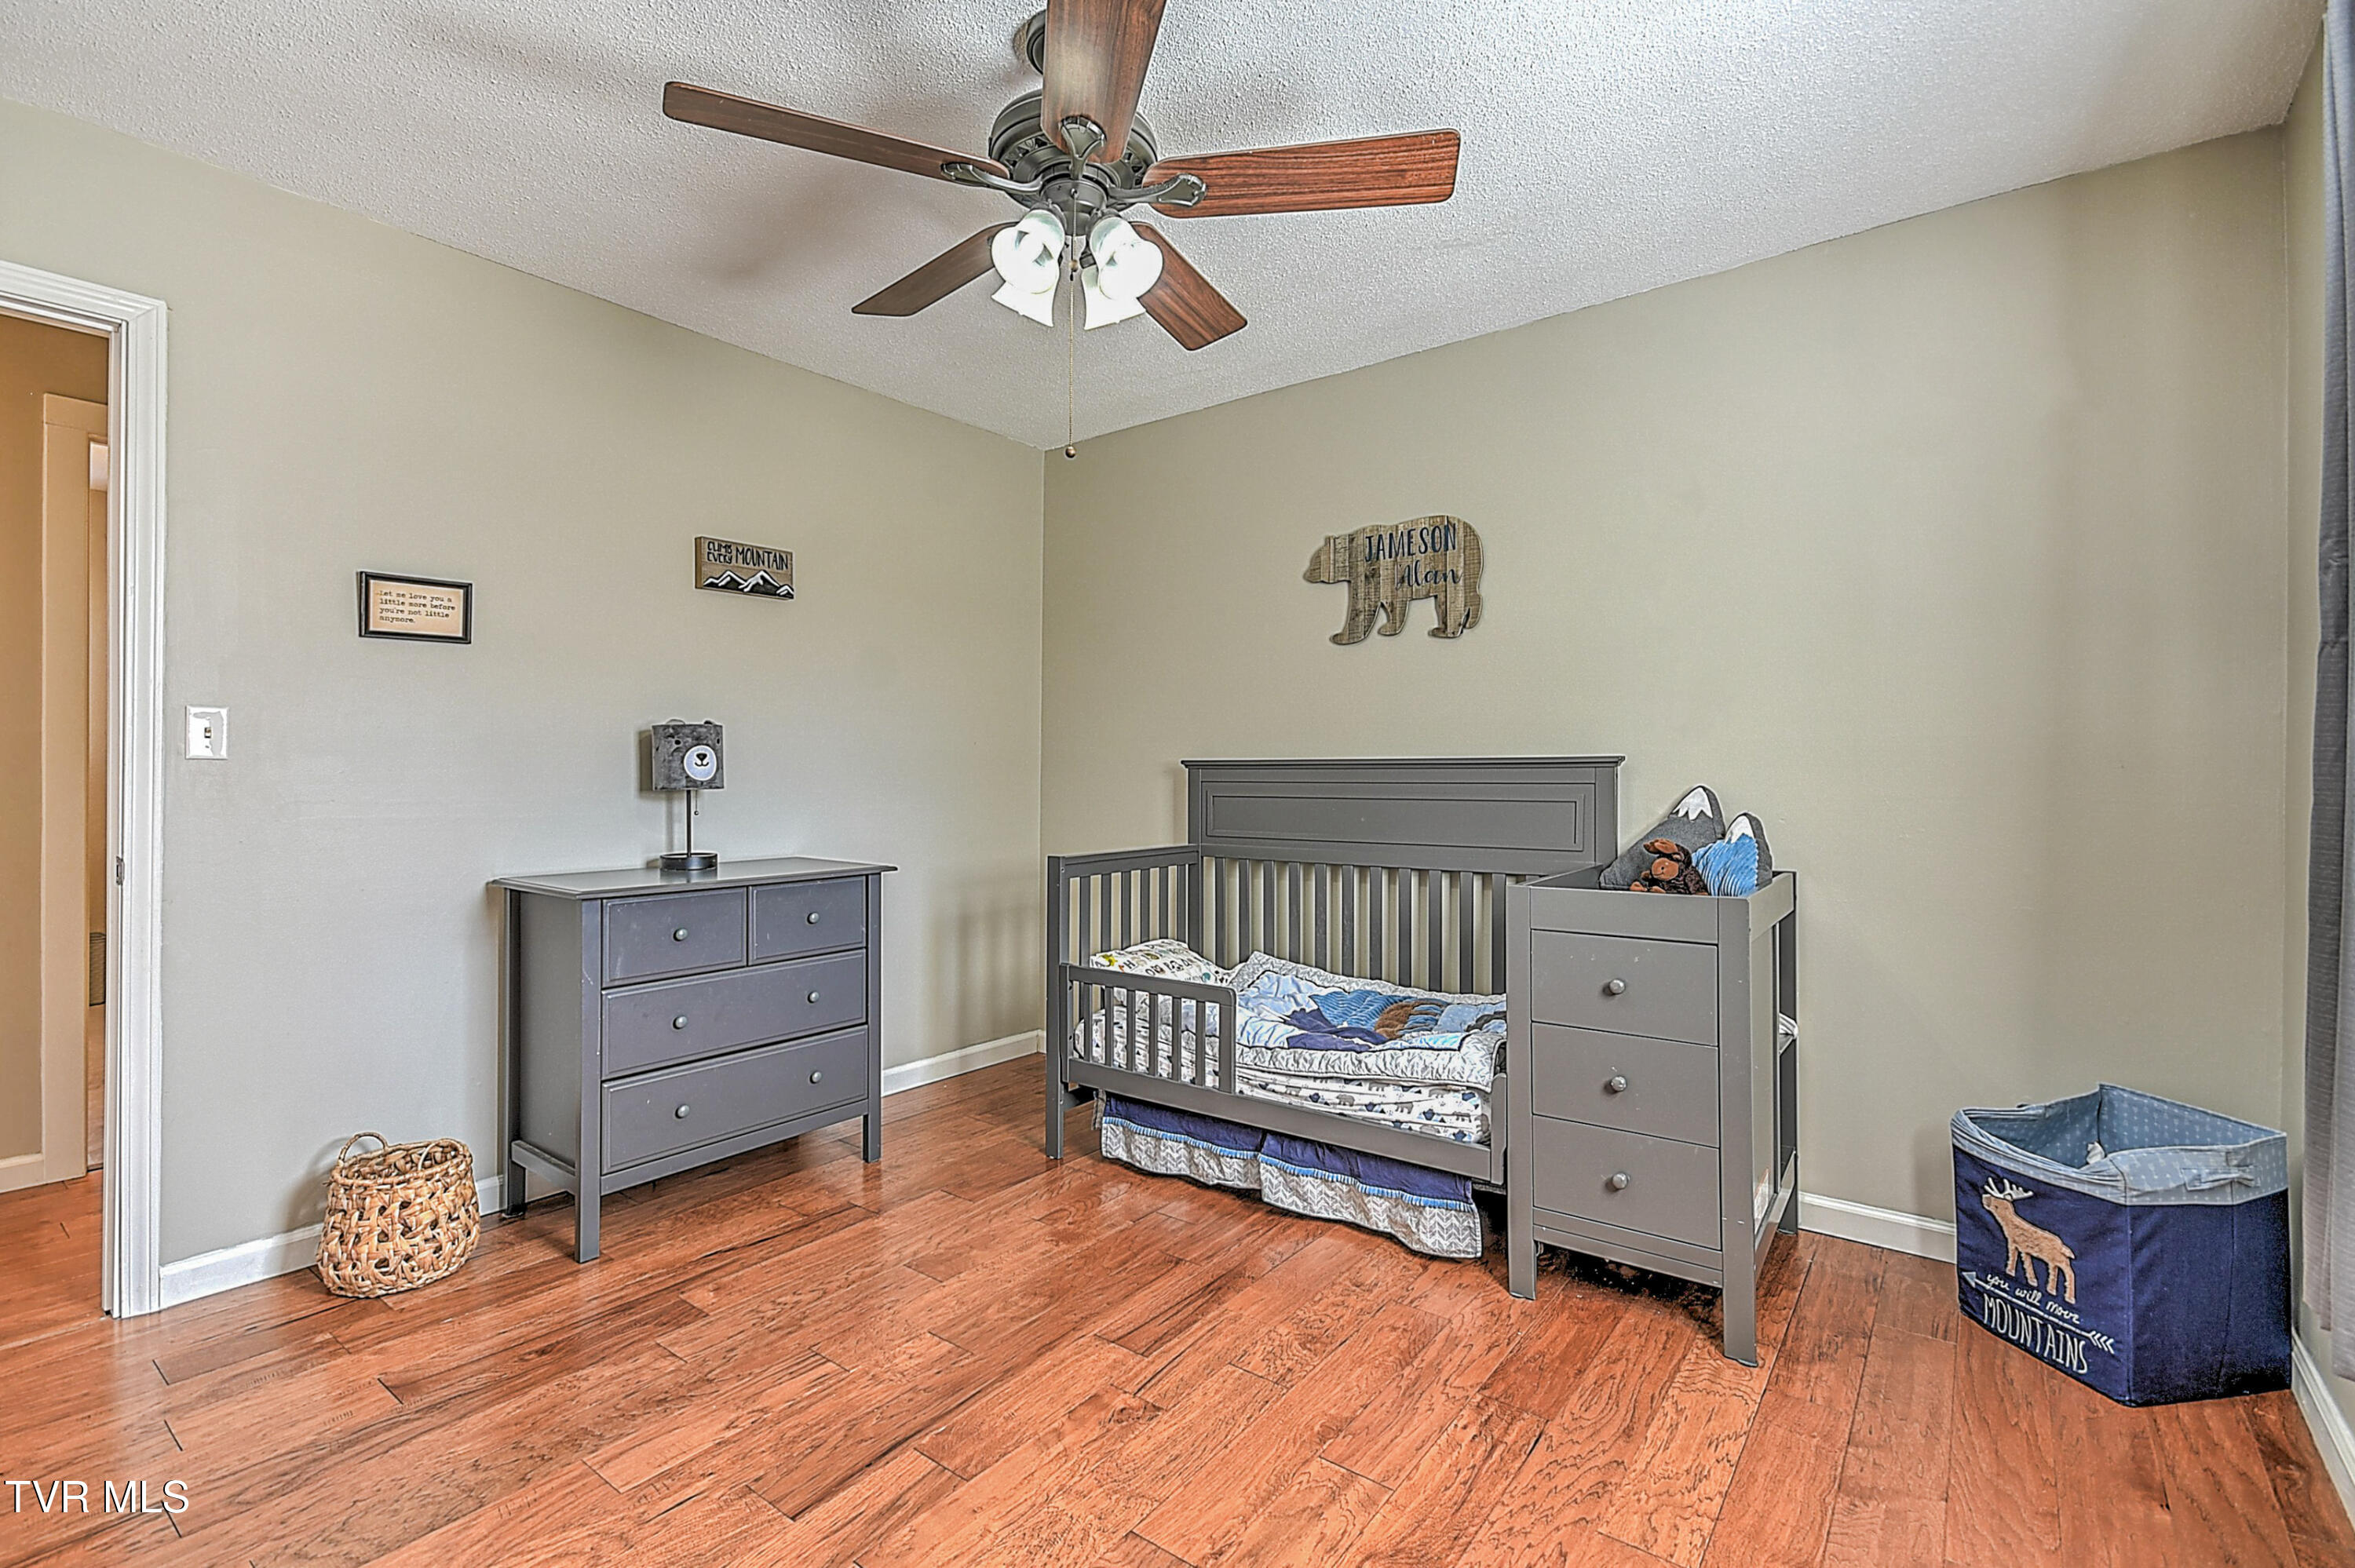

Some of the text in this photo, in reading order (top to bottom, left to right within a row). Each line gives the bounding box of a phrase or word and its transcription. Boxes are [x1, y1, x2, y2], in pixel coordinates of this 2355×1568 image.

[707, 541, 732, 554] CLIMB
[1365, 523, 1456, 562] JAMESON
[707, 552, 732, 564] EVERY
[736, 547, 788, 571] MOUNTAIN
[1396, 560, 1464, 590] Alan
[425, 610, 450, 618] little
[1986, 1273, 2080, 1324] you will move
[1984, 1293, 2088, 1373] MOUNTAINS
